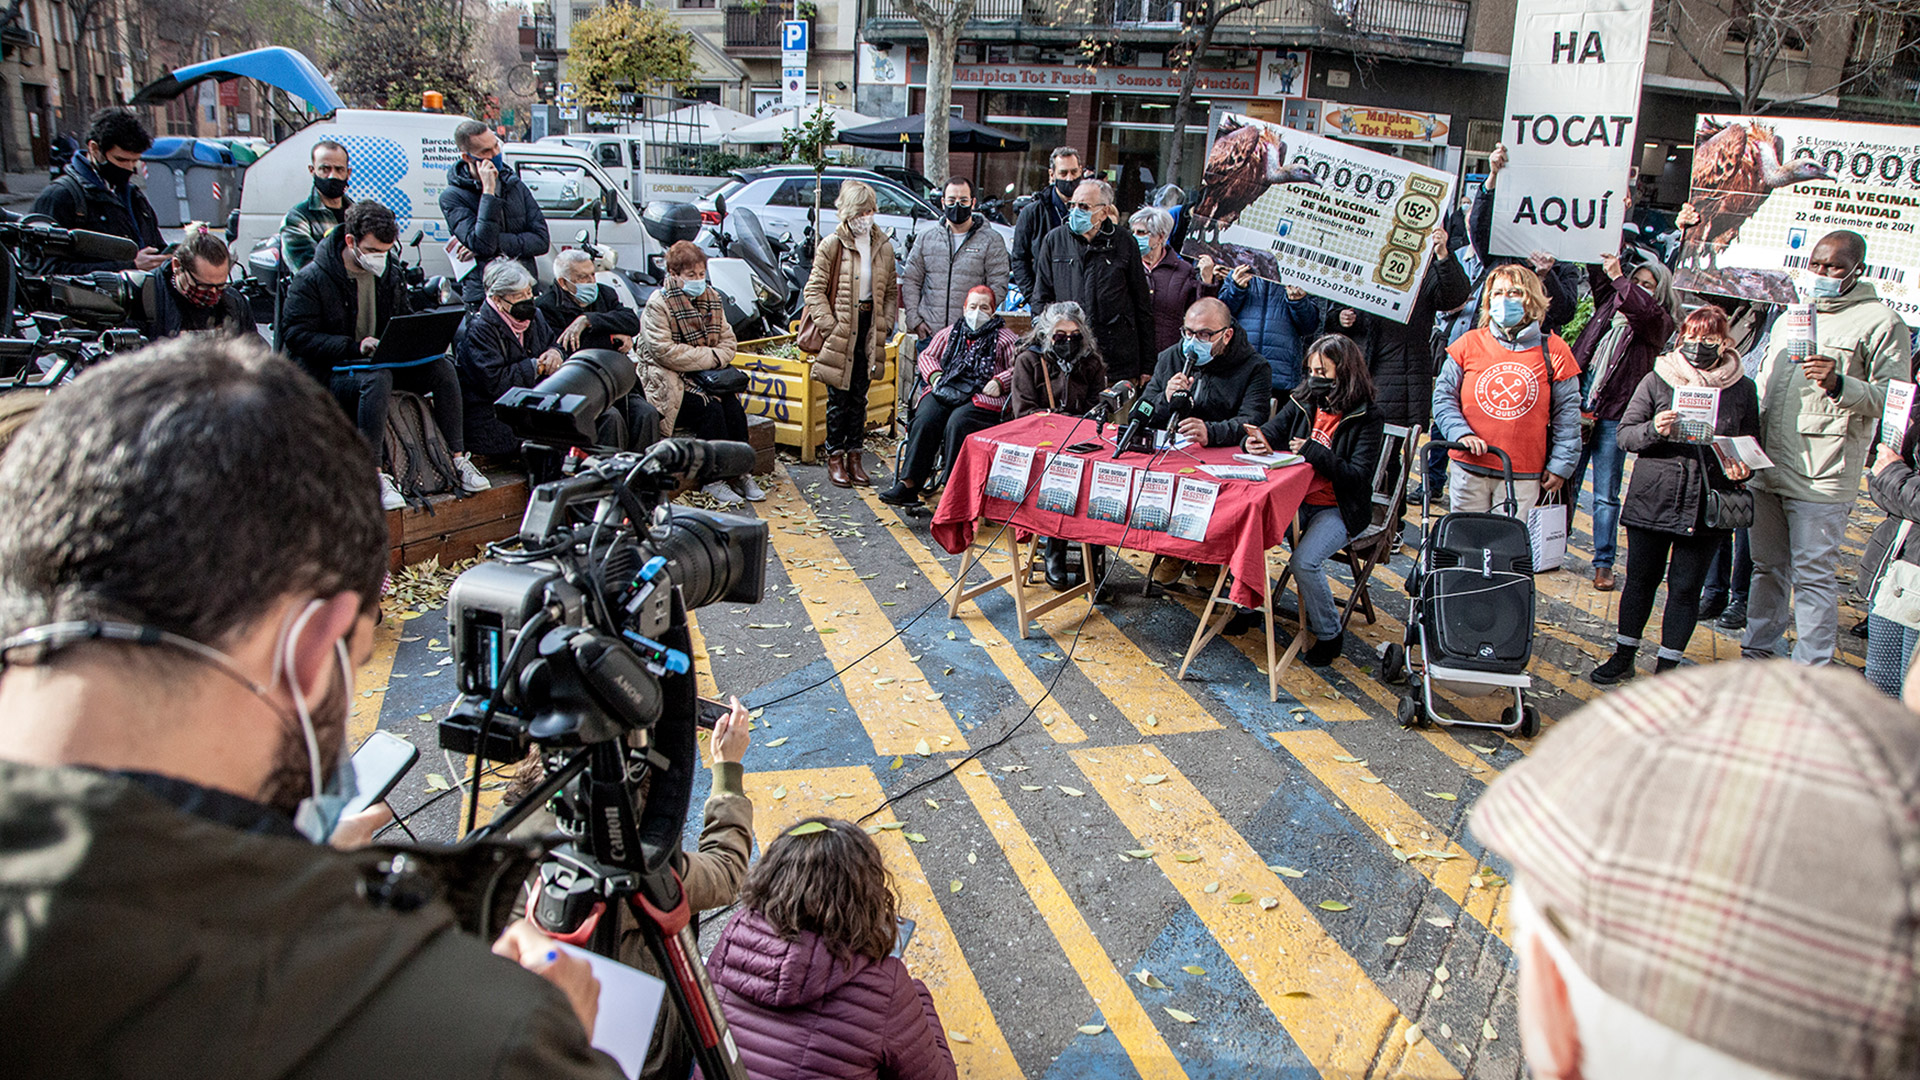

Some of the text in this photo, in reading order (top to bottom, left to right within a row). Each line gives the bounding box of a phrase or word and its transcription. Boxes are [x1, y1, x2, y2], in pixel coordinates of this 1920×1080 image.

[1551, 31, 1606, 65] HA
[955, 68, 1017, 85] Malpica
[1019, 69, 1047, 84] Tot
[1051, 70, 1097, 85] Fusta
[1117, 73, 1163, 87] Somos
[1196, 76, 1249, 90] olución
[756, 100, 772, 114] BAR
[1366, 110, 1412, 125] Malpica
[421, 137, 456, 146] Barcelo
[1360, 123, 1415, 139] Tot Fusta
[1511, 114, 1634, 147] TOCAT
[421, 146, 436, 154] pel
[1413, 180, 1438, 193] 102/21
[1793, 185, 1920, 208] LOTERÍA VECINAL
[1287, 184, 1381, 218] LOTERÍA VECINAL
[1301, 199, 1367, 225] DE NAVIDAD
[1512, 190, 1614, 232] AQUÍ
[1813, 200, 1901, 219] DE NAVIDAD
[1285, 206, 1295, 215] 22
[1295, 207, 1306, 218] de
[1306, 210, 1344, 229] diciembre
[1344, 222, 1355, 232] de
[1355, 227, 1375, 239] 2021
[1795, 211, 1915, 234] 22 de diciembre de 2021
[1388, 260, 1406, 275] 20
[1478, 366, 1501, 394] SINDICAT
[1481, 400, 1527, 417] ENS QUEDEM
[604, 806, 627, 861] Canon
